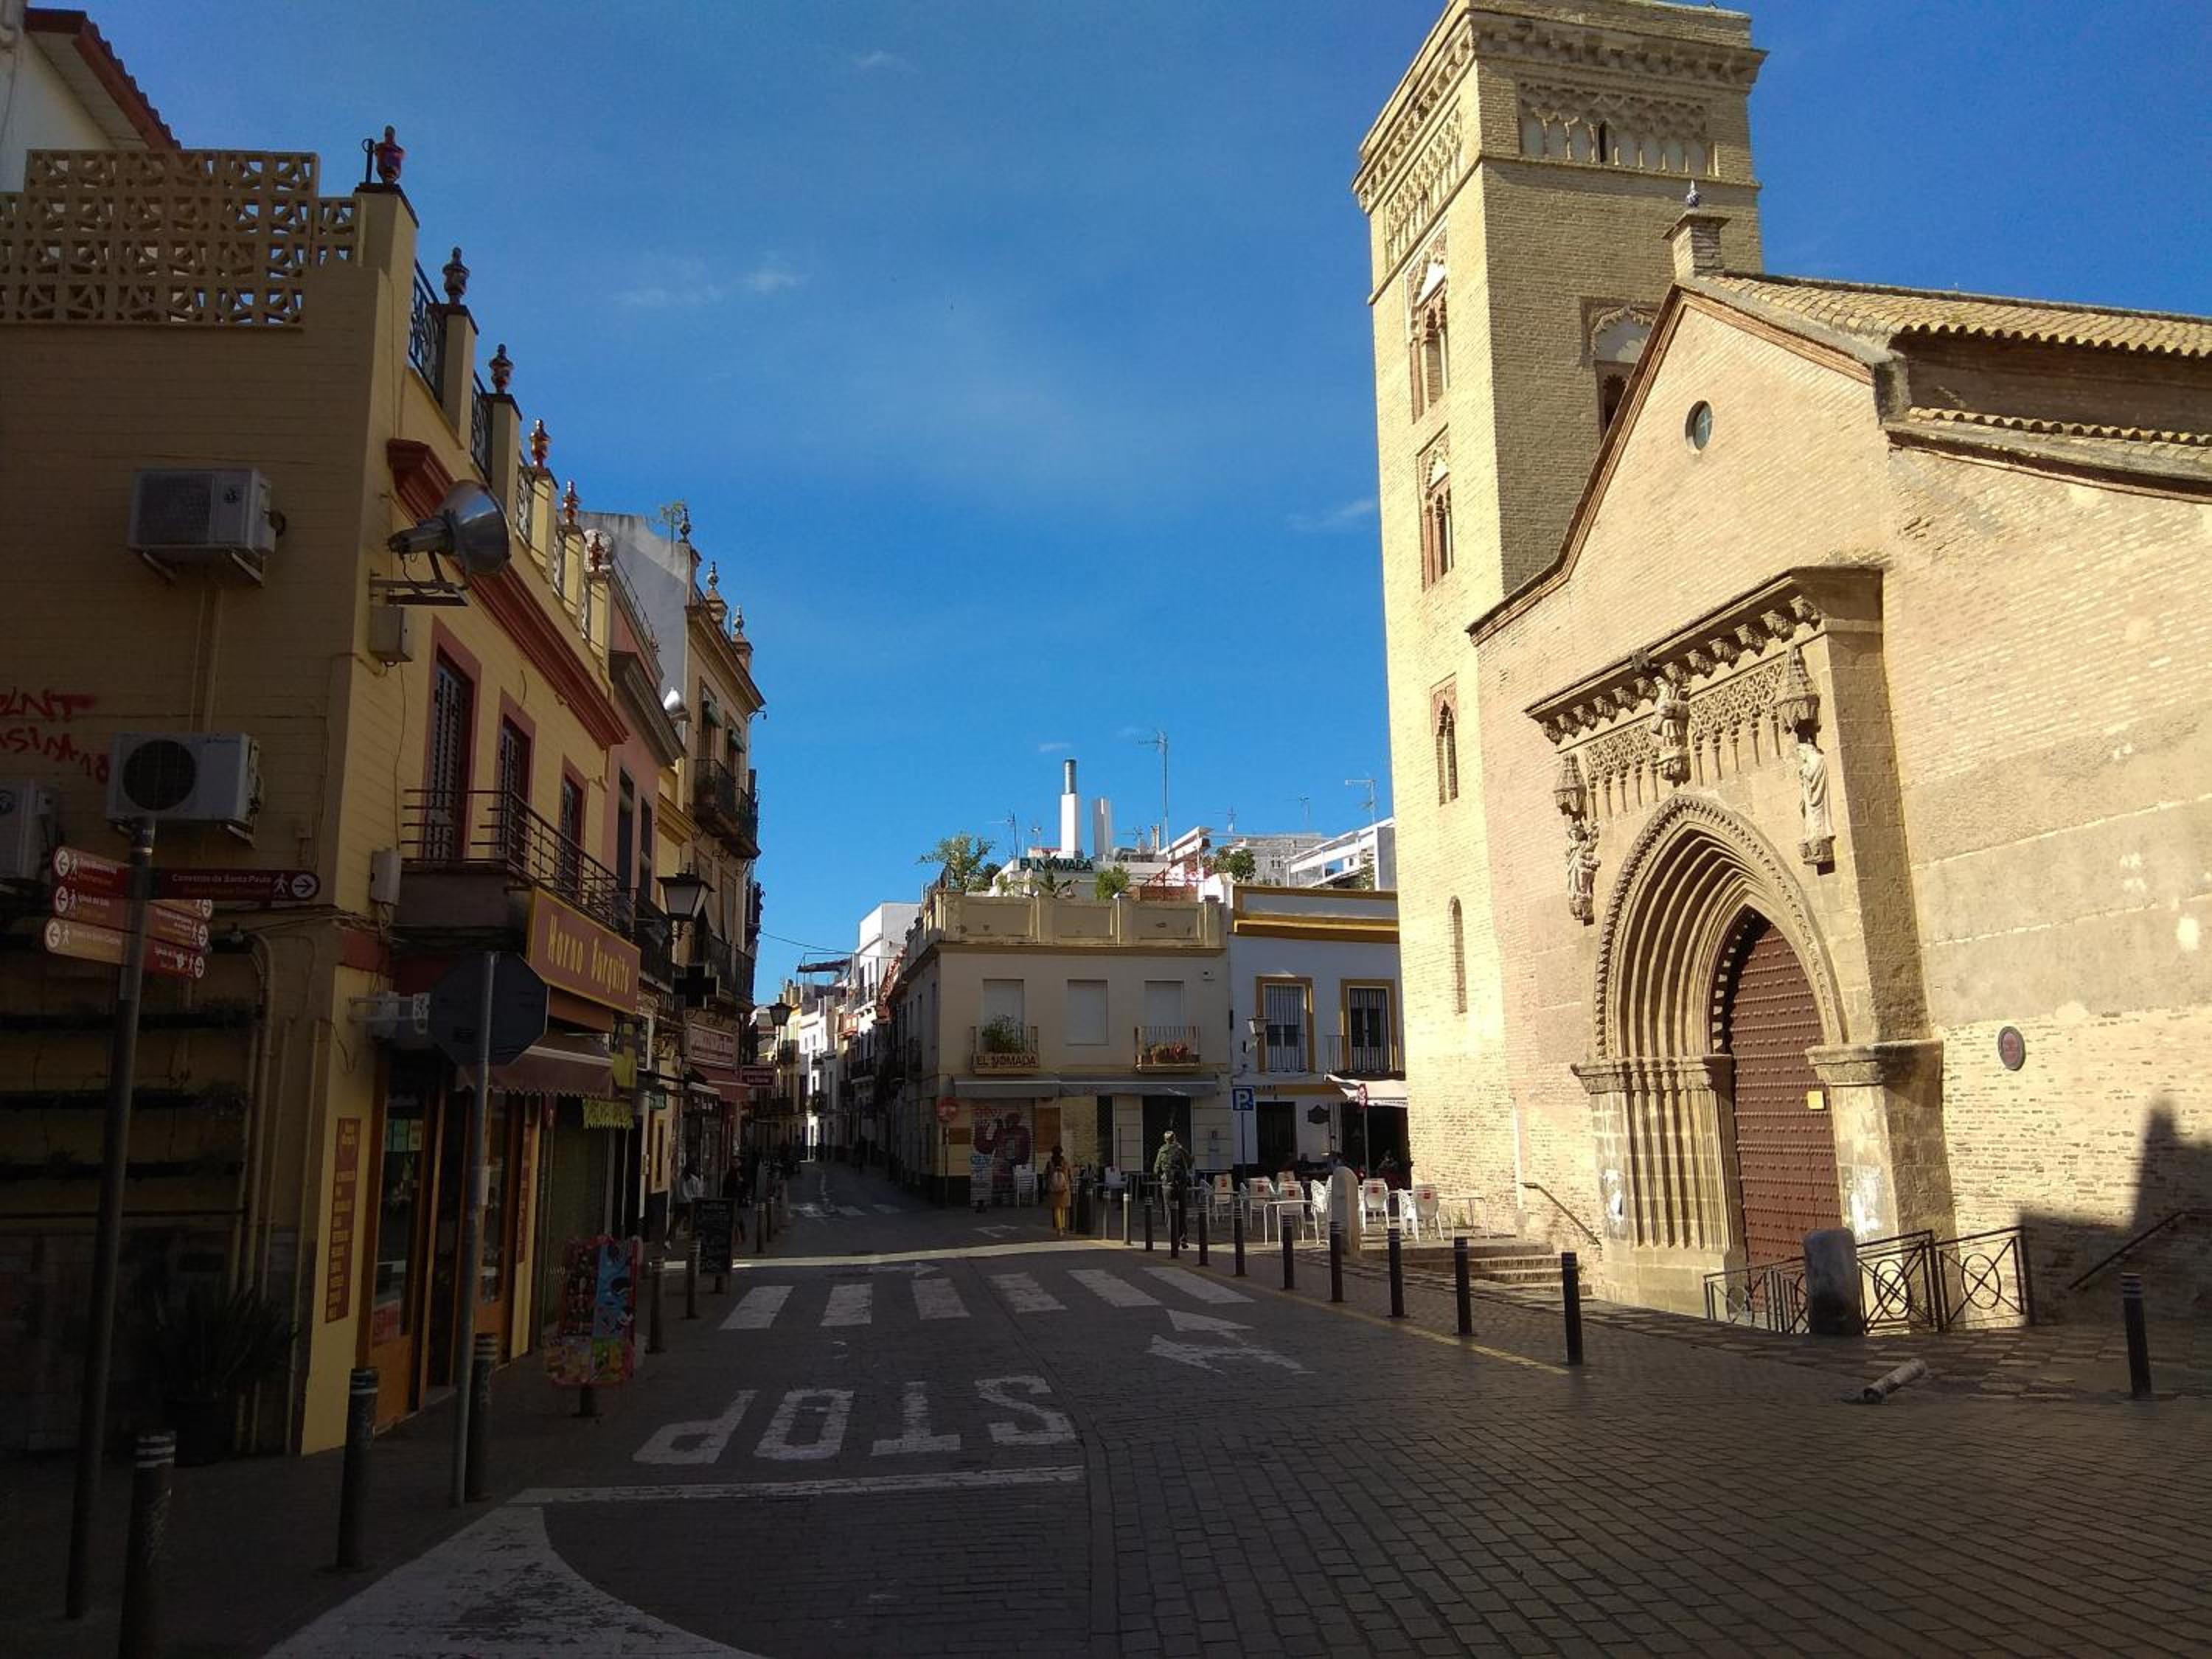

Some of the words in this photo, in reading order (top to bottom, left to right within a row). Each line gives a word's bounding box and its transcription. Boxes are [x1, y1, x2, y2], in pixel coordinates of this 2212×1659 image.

[548, 913, 583, 975] Horno
[977, 1055, 989, 1065] EL
[1235, 1090, 1249, 1109] P
[632, 1374, 1083, 1464] STOP
